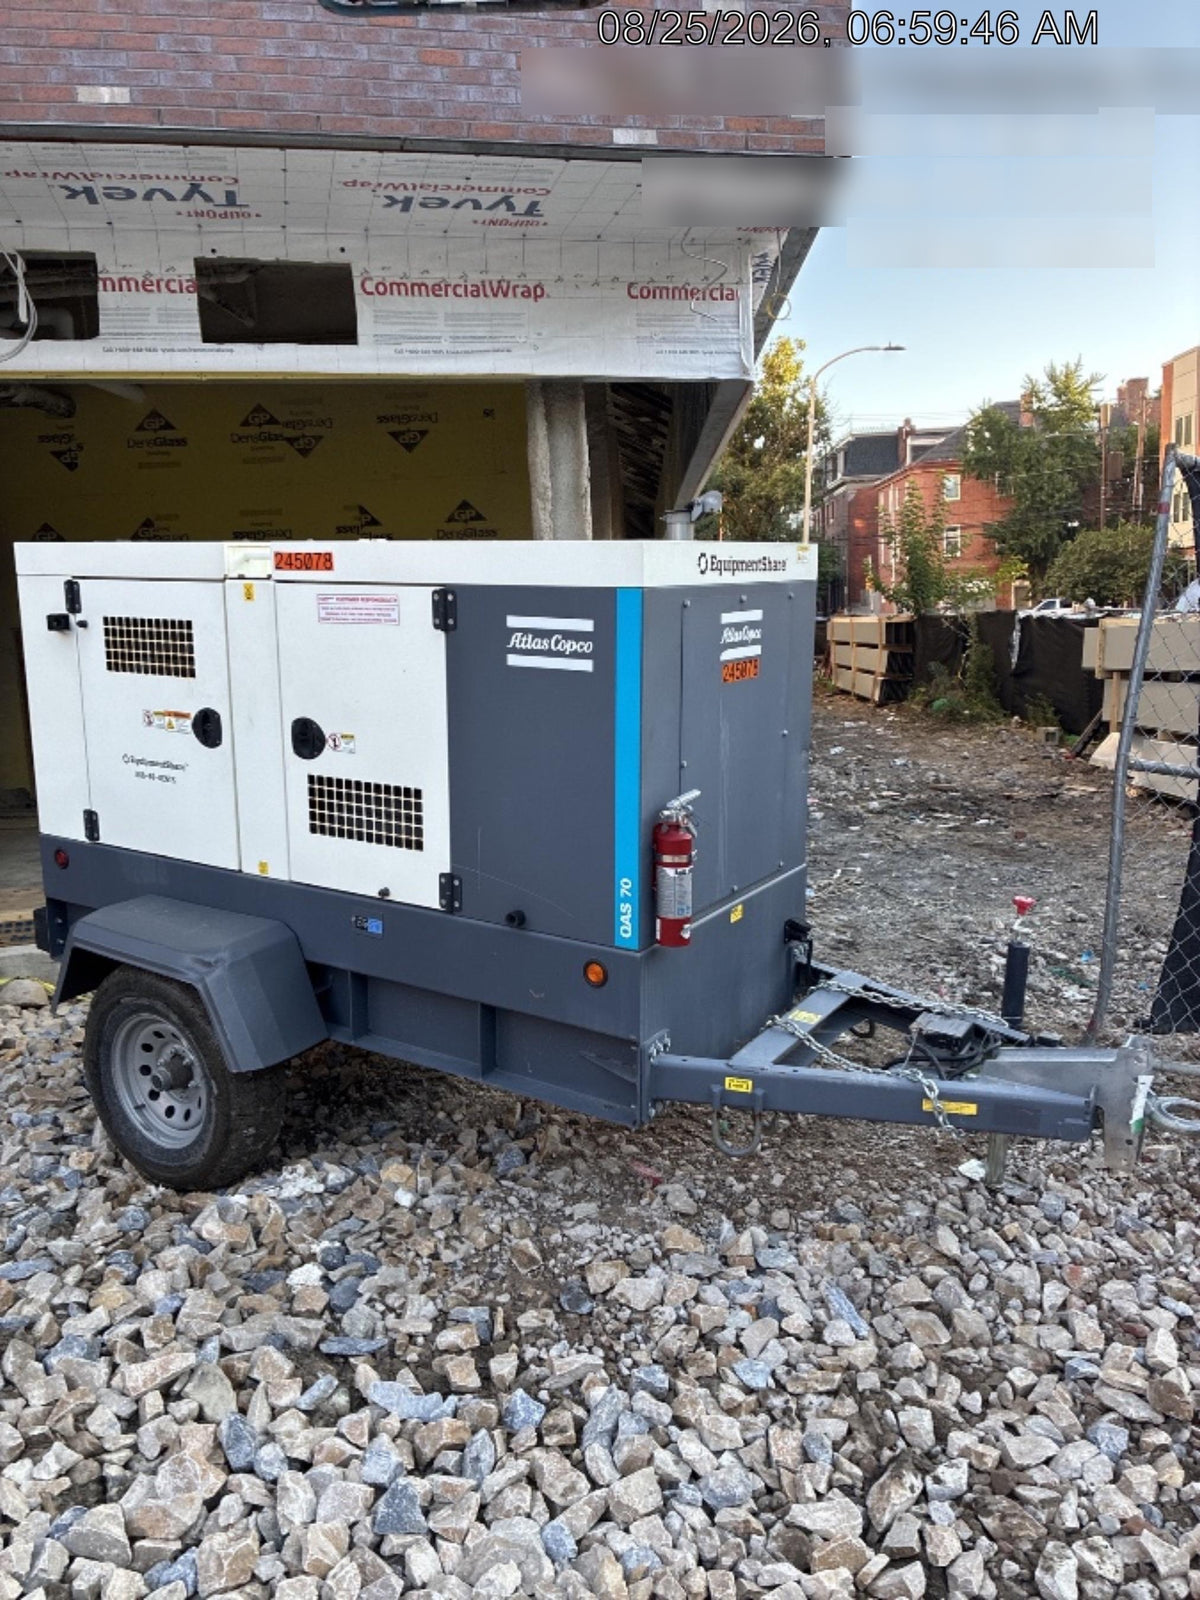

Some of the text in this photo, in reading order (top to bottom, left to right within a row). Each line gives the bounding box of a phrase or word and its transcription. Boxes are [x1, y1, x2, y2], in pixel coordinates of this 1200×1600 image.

[4, 169, 239, 186] CommercialWrap
[342, 179, 551, 197] CommercialWrap
[59, 182, 250, 208] Tyvek
[382, 195, 544, 217] Tyvek
[360, 276, 546, 302] CommercialWrap
[143, 418, 166, 430] GP
[274, 552, 333, 570] 245078
[710, 555, 788, 576] EquipmentShare
[506, 632, 593, 655] Atlas Copco
[620, 878, 632, 938] QAS 70
